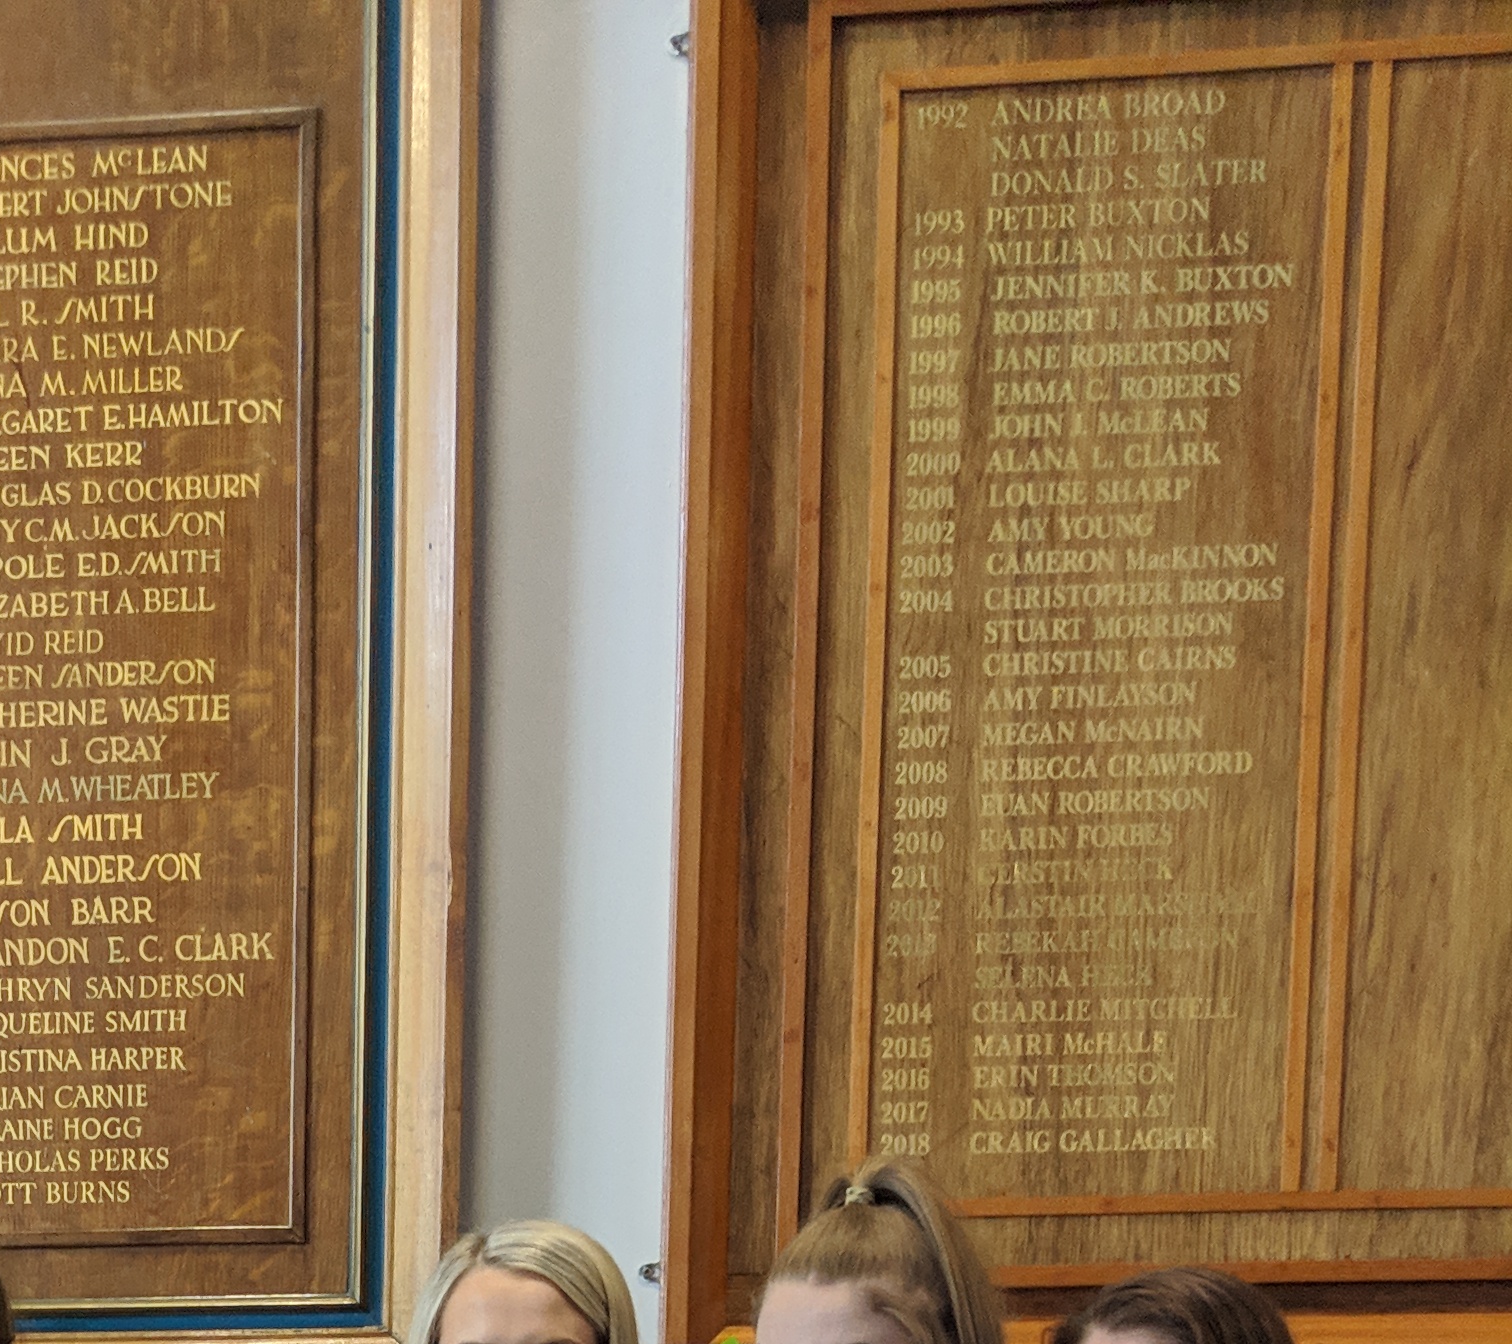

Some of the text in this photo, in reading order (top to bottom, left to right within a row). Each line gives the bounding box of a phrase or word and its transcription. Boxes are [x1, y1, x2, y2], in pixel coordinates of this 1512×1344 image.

[57, 180, 232, 214] JOHNSTONE
[44, 629, 105, 656] REID
[41, 852, 202, 885] ANDERSON
[71, 896, 156, 925] BARR
[91, 1046, 187, 1071] HARPER
[54, 1083, 148, 1109] CARNIE
[46, 1180, 131, 1204] BURNS
